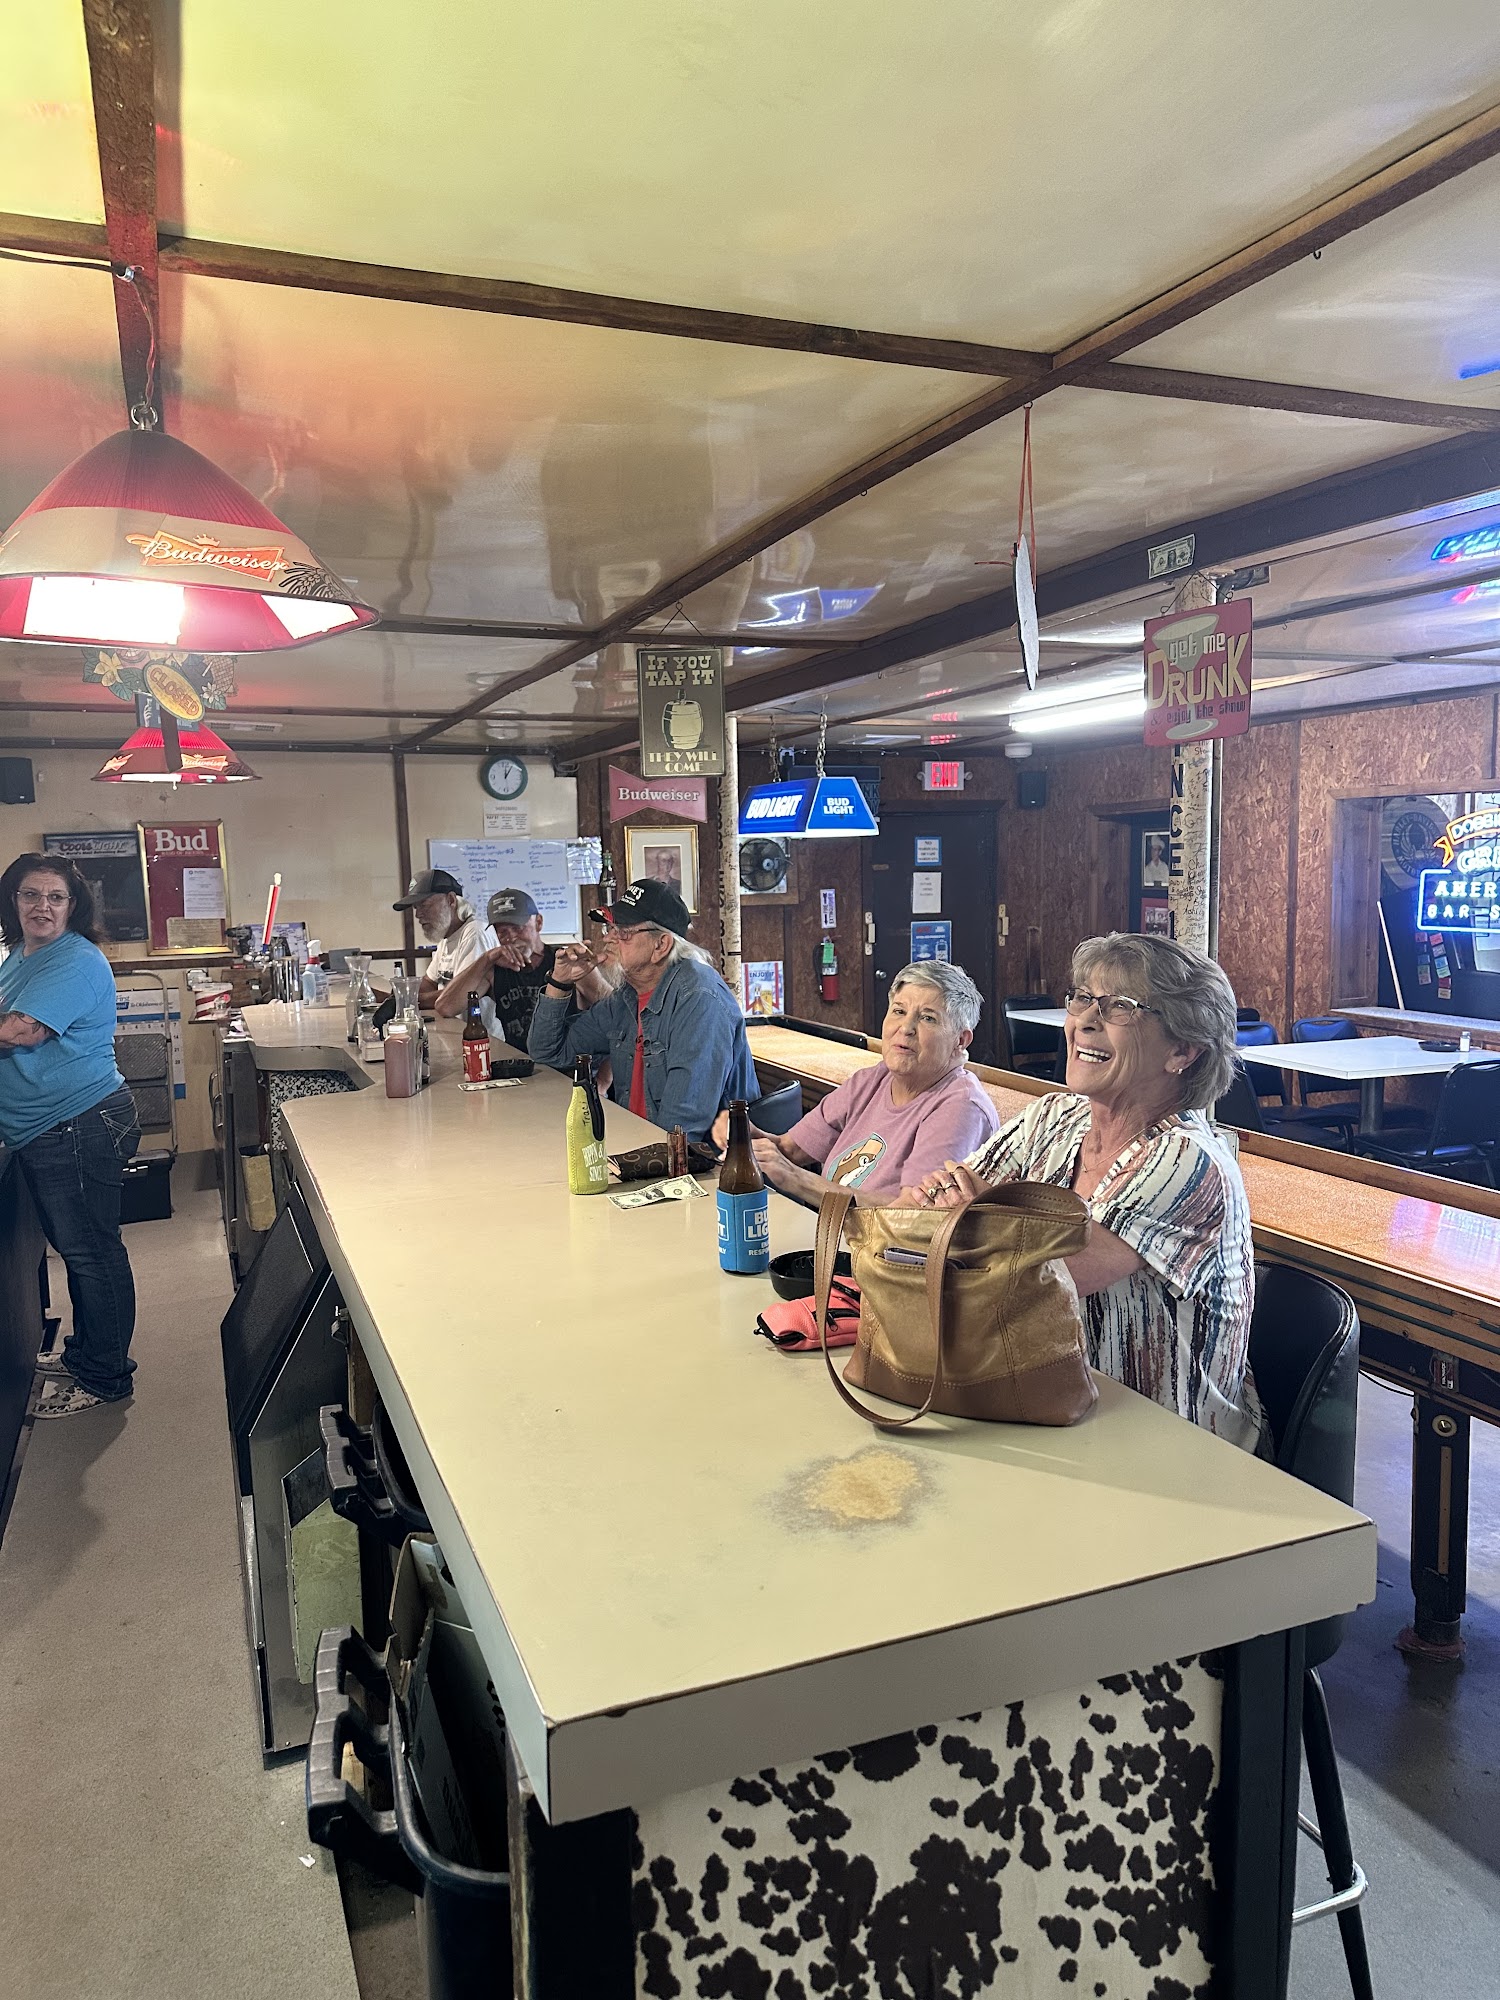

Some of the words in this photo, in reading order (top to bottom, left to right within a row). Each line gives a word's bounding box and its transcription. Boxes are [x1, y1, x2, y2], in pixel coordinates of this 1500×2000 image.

[132, 537, 288, 571] Budweiser
[1169, 632, 1198, 666] get
[1203, 632, 1226, 655] me
[647, 655, 668, 671] IF
[673, 655, 712, 670] YOU
[1148, 632, 1249, 709] DRUNK
[645, 670, 687, 687] TAP
[692, 669, 715, 685] IT
[150, 667, 200, 717] CLOSED
[1166, 708, 1192, 725] enjoy
[1196, 702, 1214, 720] the
[1219, 700, 1246, 715] show
[648, 751, 683, 763] THEY
[685, 751, 719, 761] WILL
[664, 762, 705, 773] COME
[931, 762, 959, 787] EXIT
[618, 788, 700, 801] Budweiser
[826, 797, 850, 806] BUD
[746, 797, 772, 819] BUD
[768, 795, 803, 817] LIGHT
[823, 806, 855, 815] LIGHT
[1451, 813, 1500, 839] DOBBI
[153, 828, 209, 851] Bud
[1434, 880, 1498, 898] AMER
[1427, 904, 1470, 919] BAR
[754, 1211, 768, 1225] BU
[748, 1223, 768, 1238] LIG
